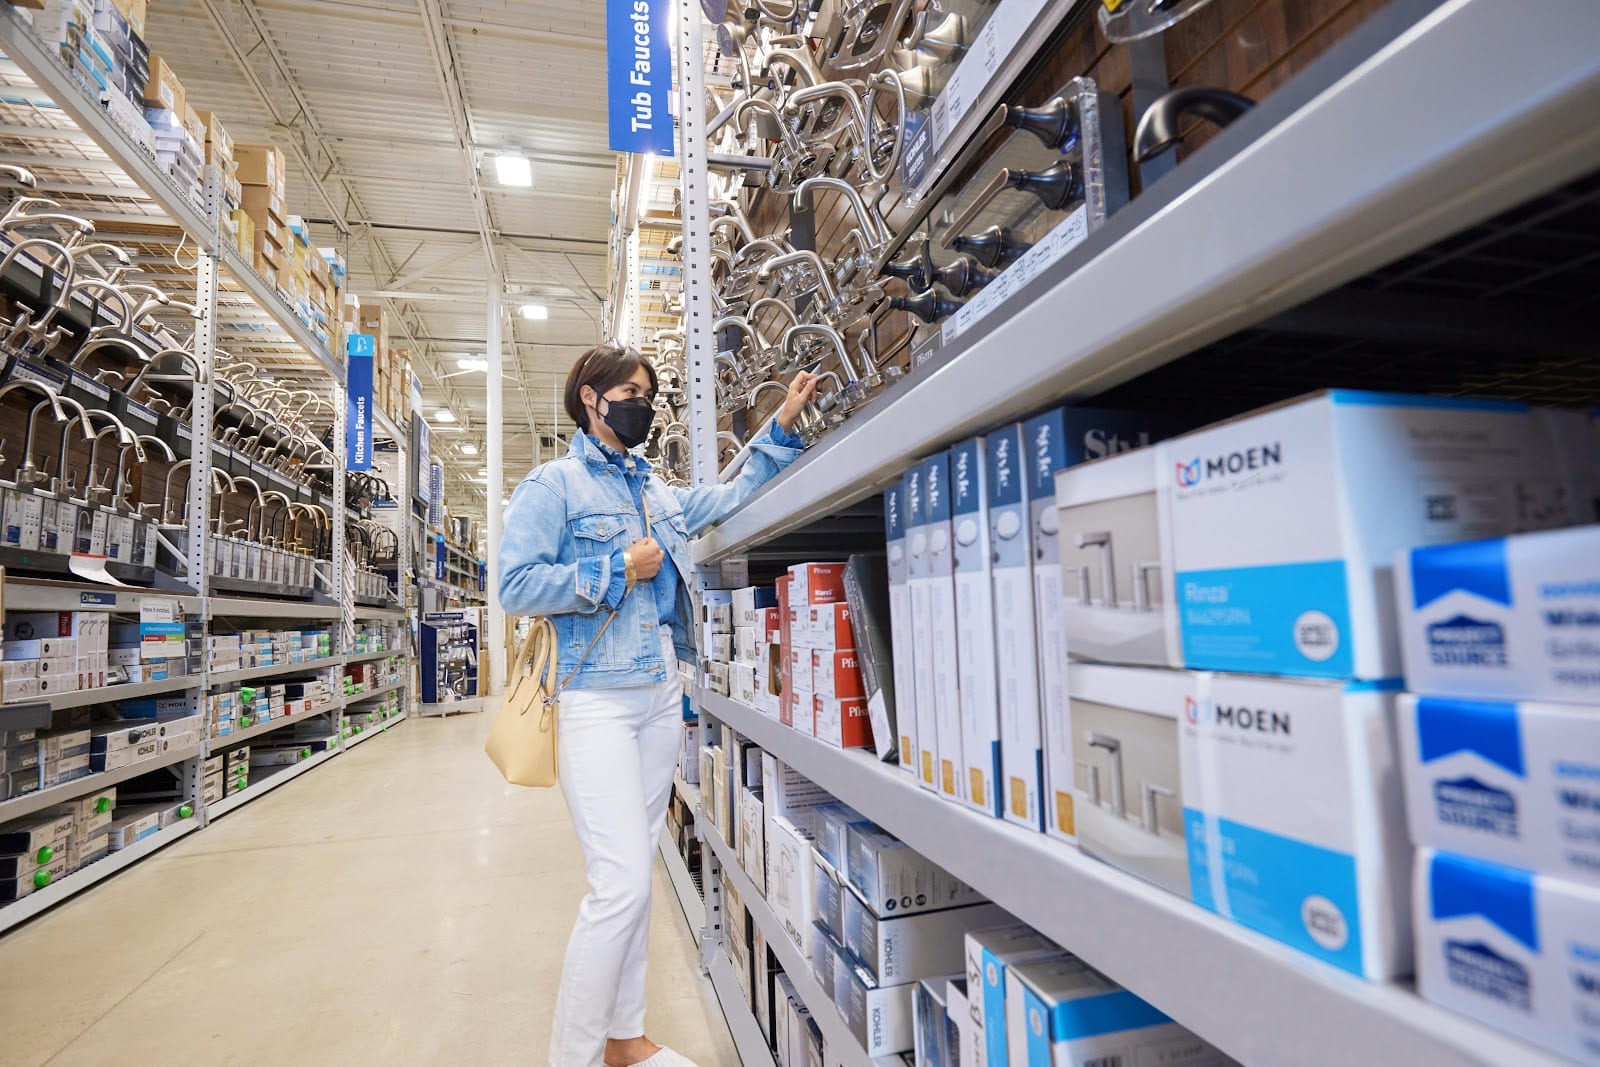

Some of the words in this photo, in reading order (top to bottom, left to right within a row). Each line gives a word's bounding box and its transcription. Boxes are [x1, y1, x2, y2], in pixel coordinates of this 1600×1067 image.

[630, 1, 652, 87] Faucets
[631, 92, 652, 133] Tub
[355, 396, 365, 430] Faucets
[355, 430, 364, 464] Kitchen
[1206, 441, 1282, 479] MOEN
[1216, 703, 1291, 735] MOEN
[884, 938, 893, 978] KOHLER
[872, 1007, 882, 1049] KOHLER
